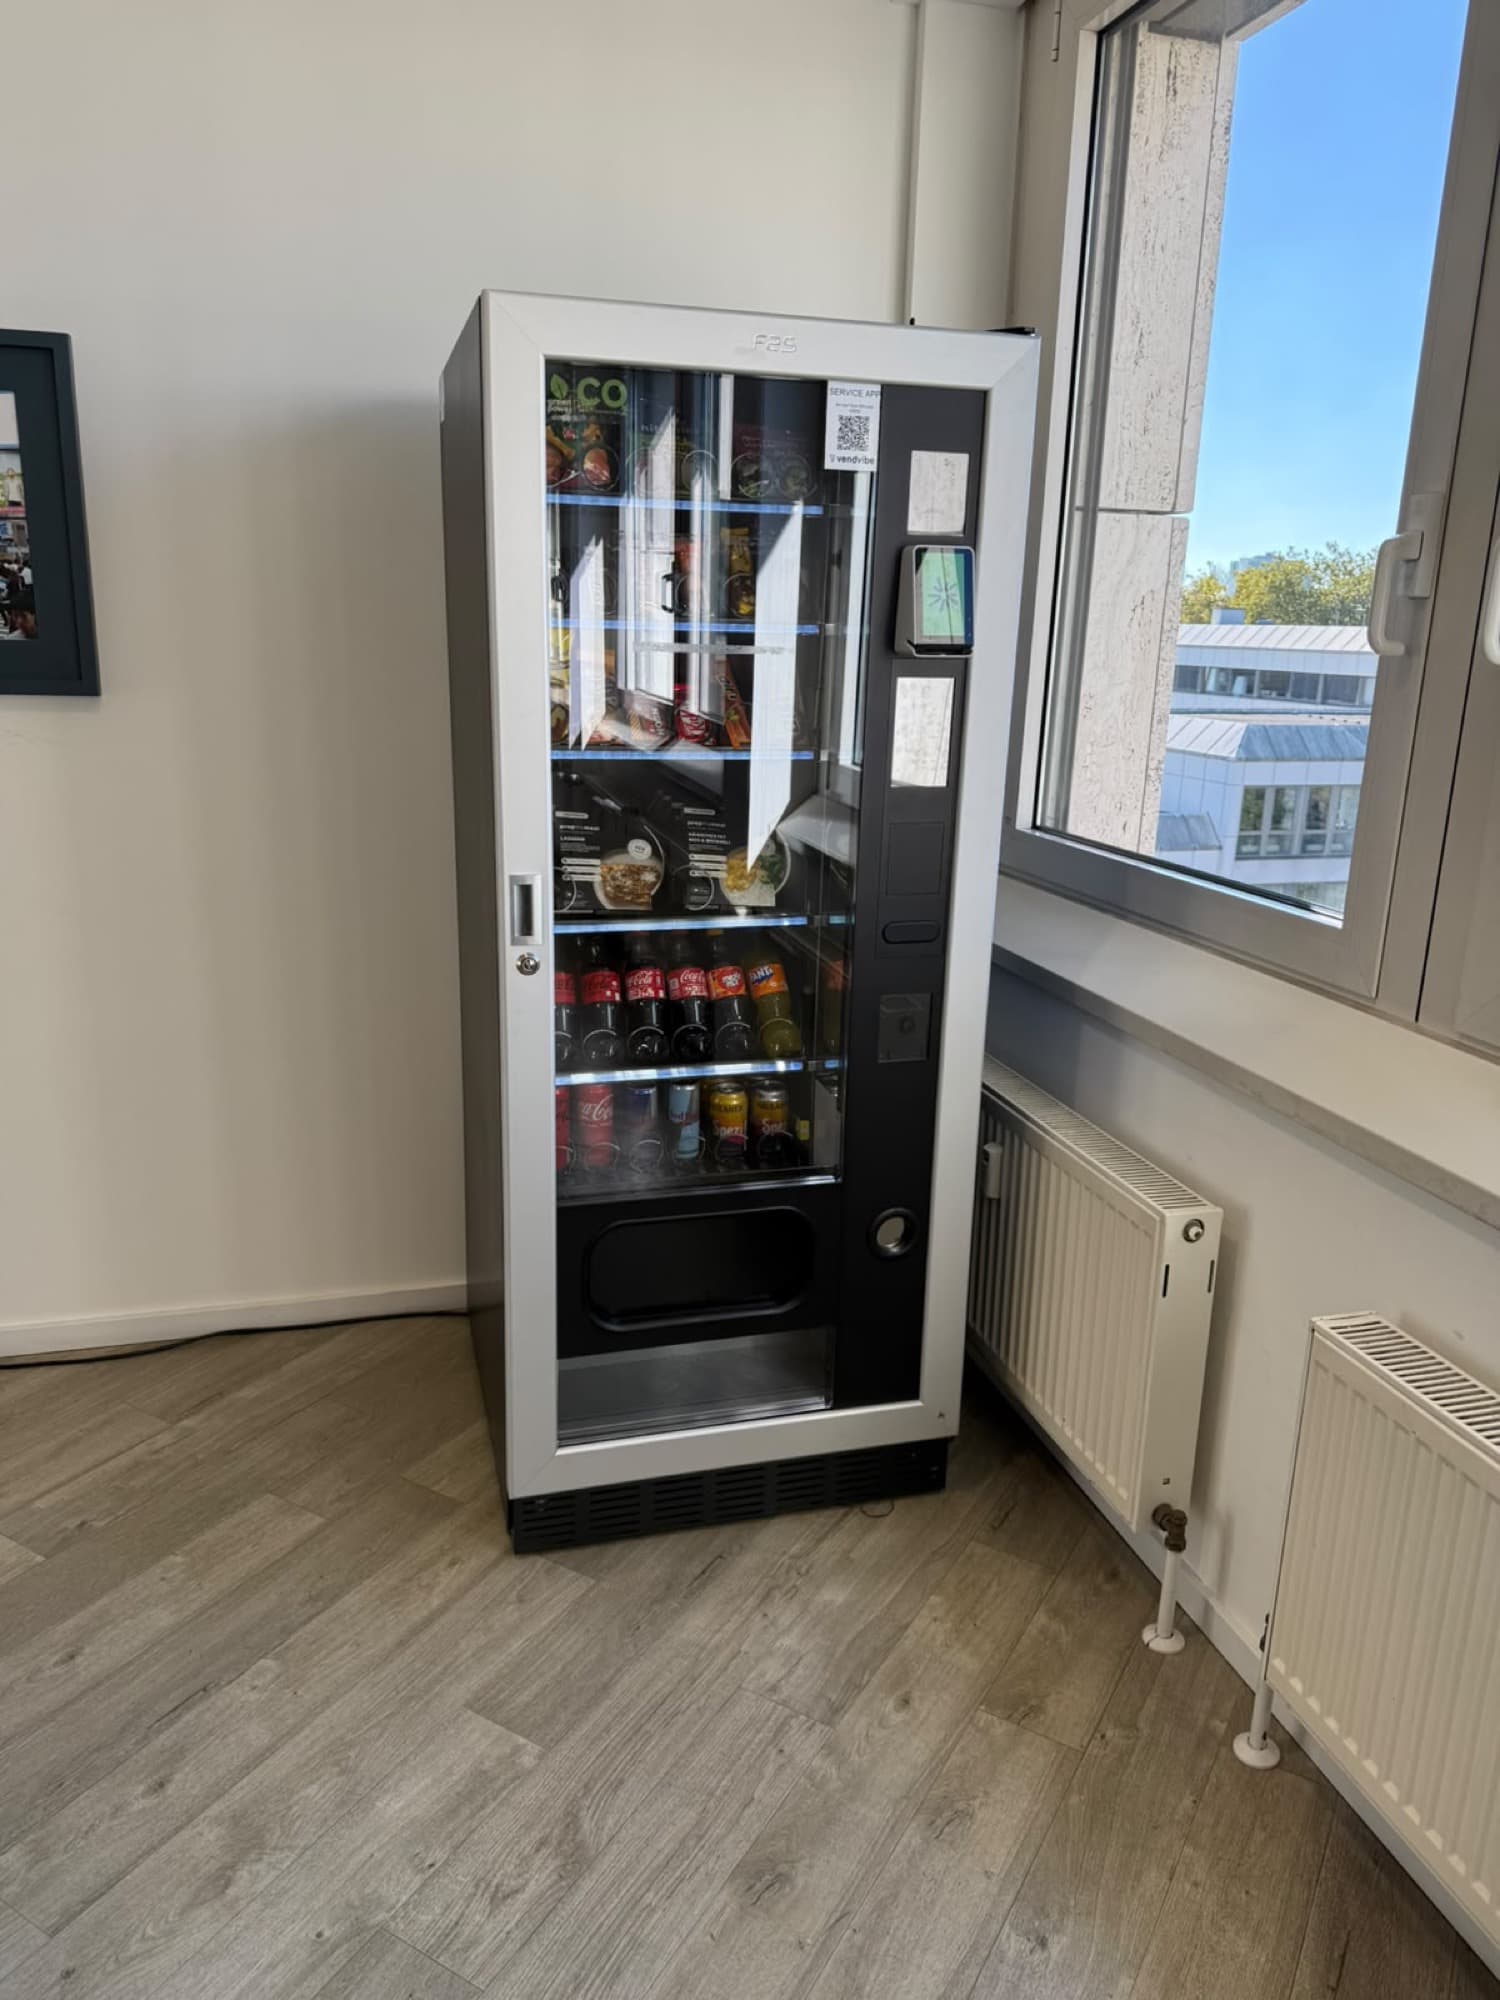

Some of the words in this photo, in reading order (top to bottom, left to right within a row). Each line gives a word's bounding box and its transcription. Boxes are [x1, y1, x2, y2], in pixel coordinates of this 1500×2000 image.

[830, 387, 864, 398] SERVICE
[866, 389, 881, 399] APP
[836, 455, 875, 465] vendvibe
